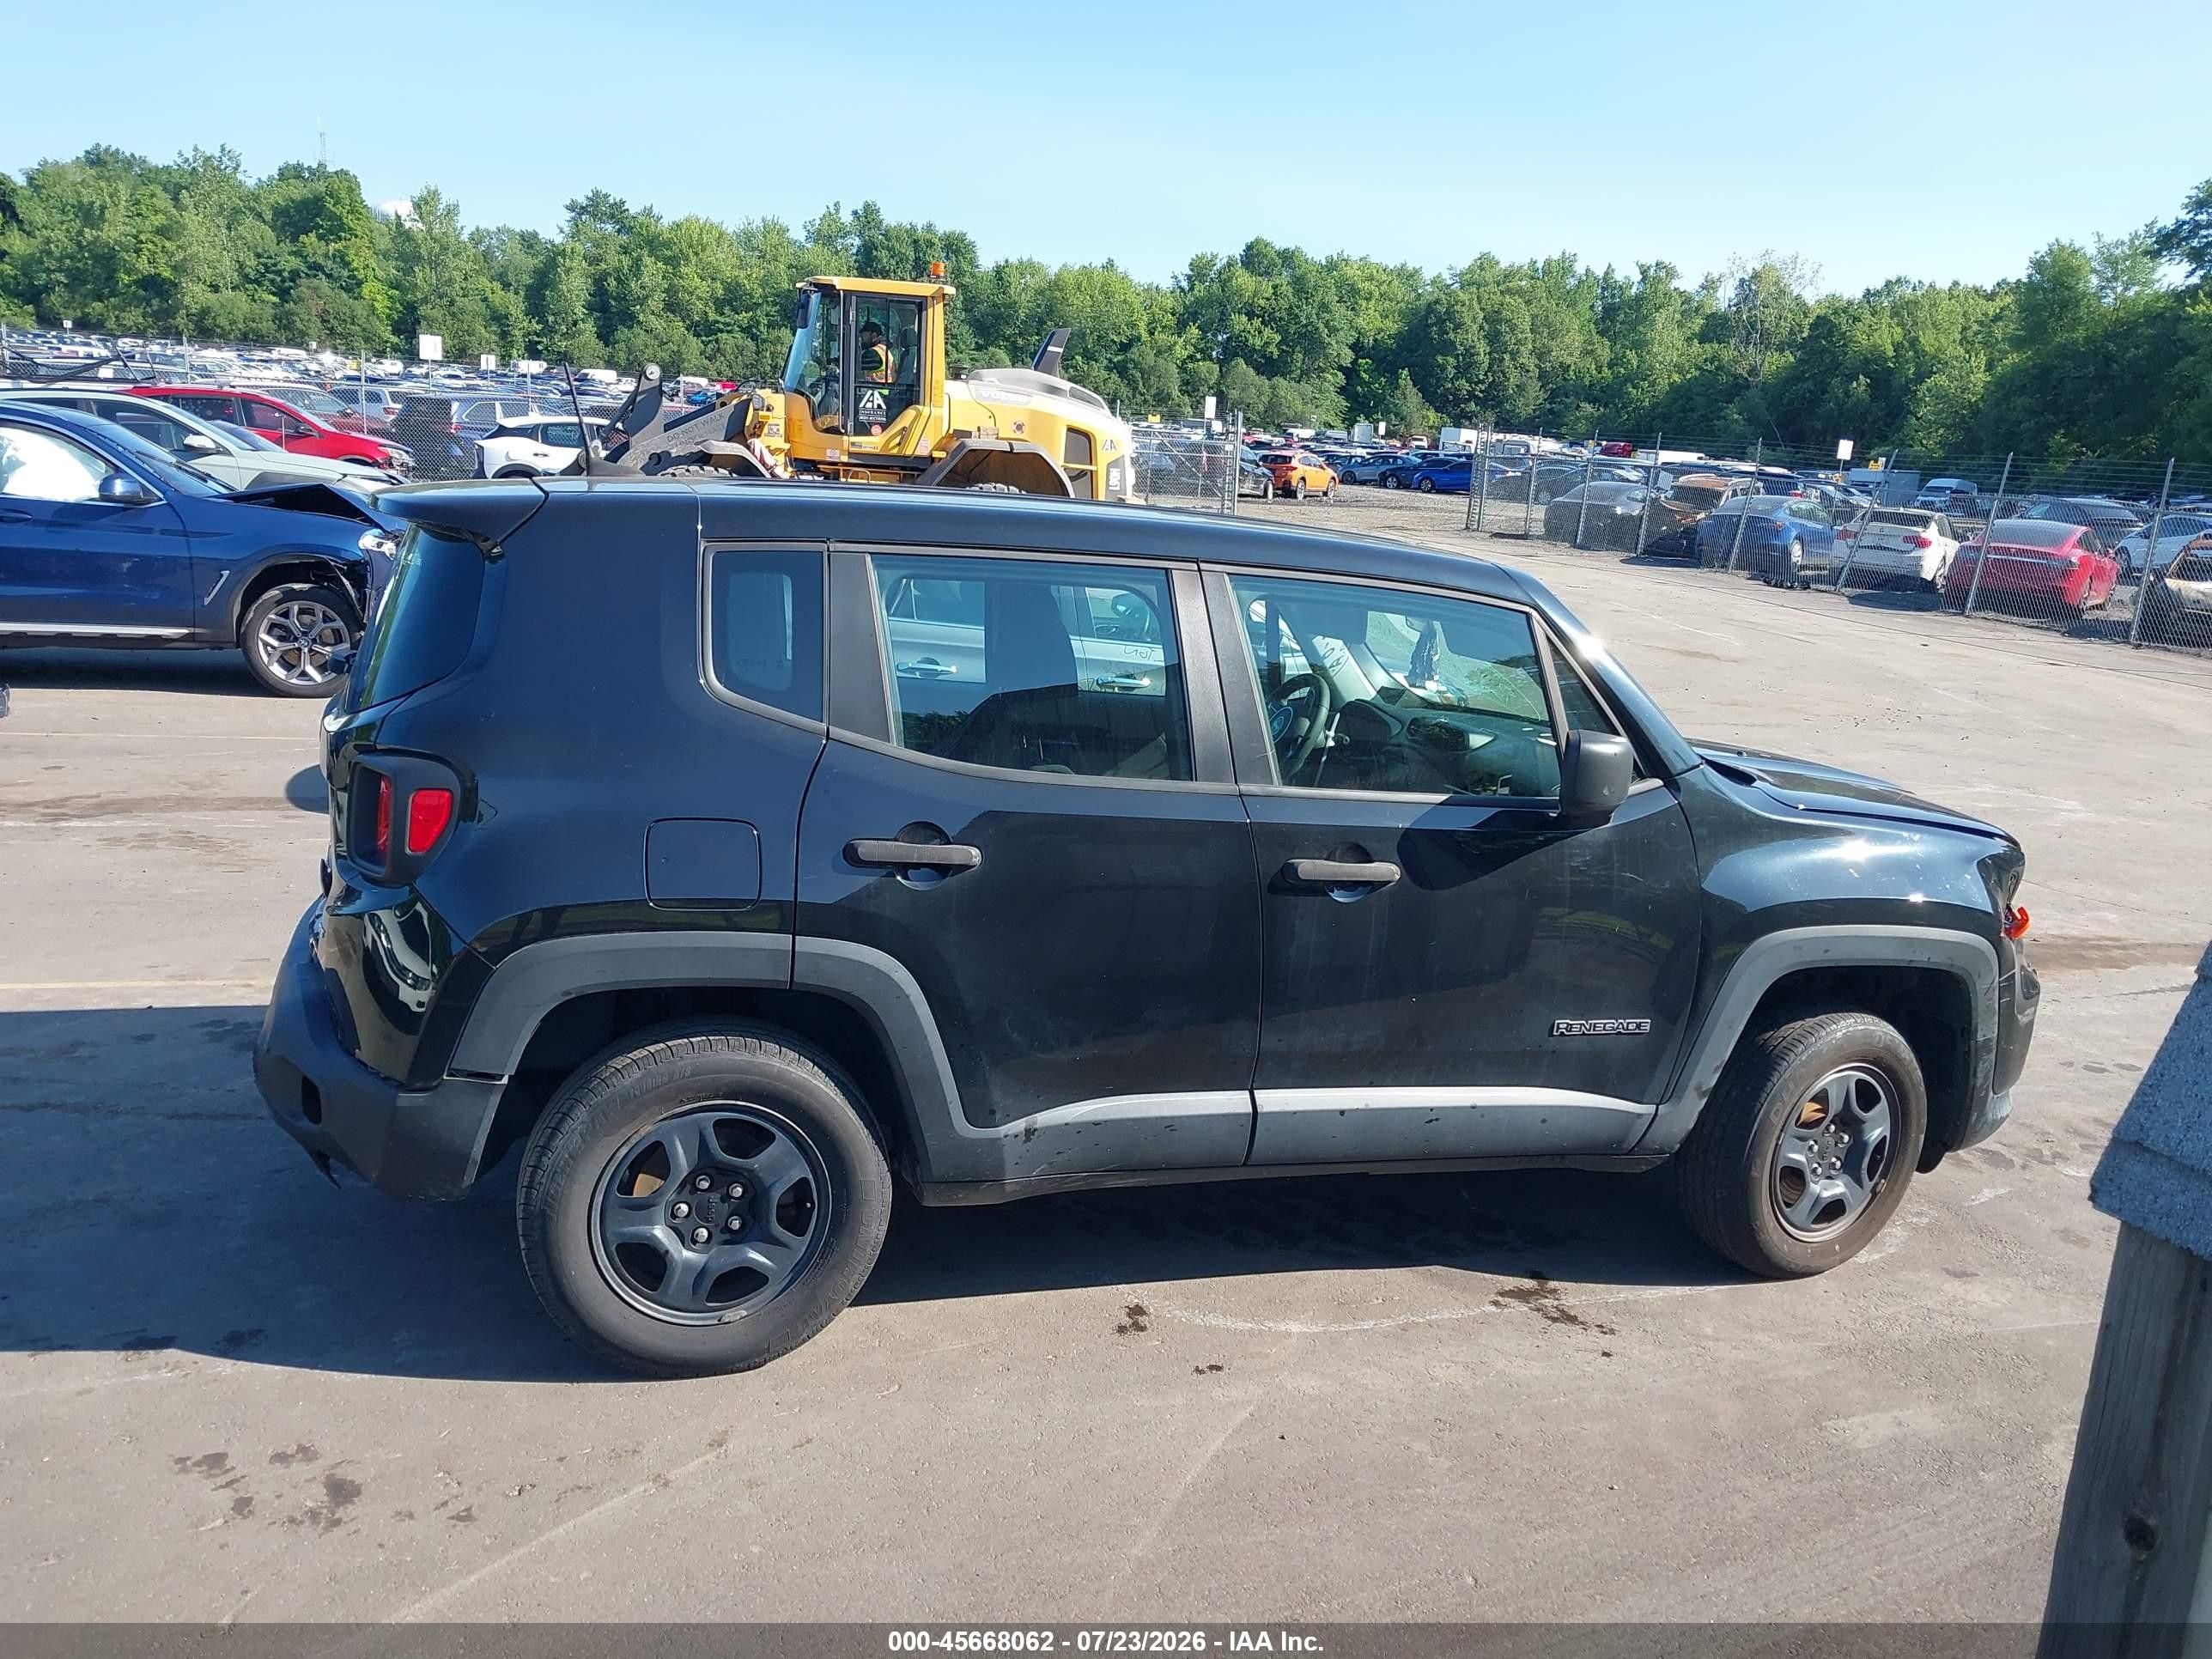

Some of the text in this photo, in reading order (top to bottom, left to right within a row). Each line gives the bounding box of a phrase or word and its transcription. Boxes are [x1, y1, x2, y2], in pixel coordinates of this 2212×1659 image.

[666, 432, 680, 443] DO
[681, 424, 700, 436] NOT
[701, 412, 726, 427] WALK
[1553, 1018, 1651, 1036] RENEGADE
